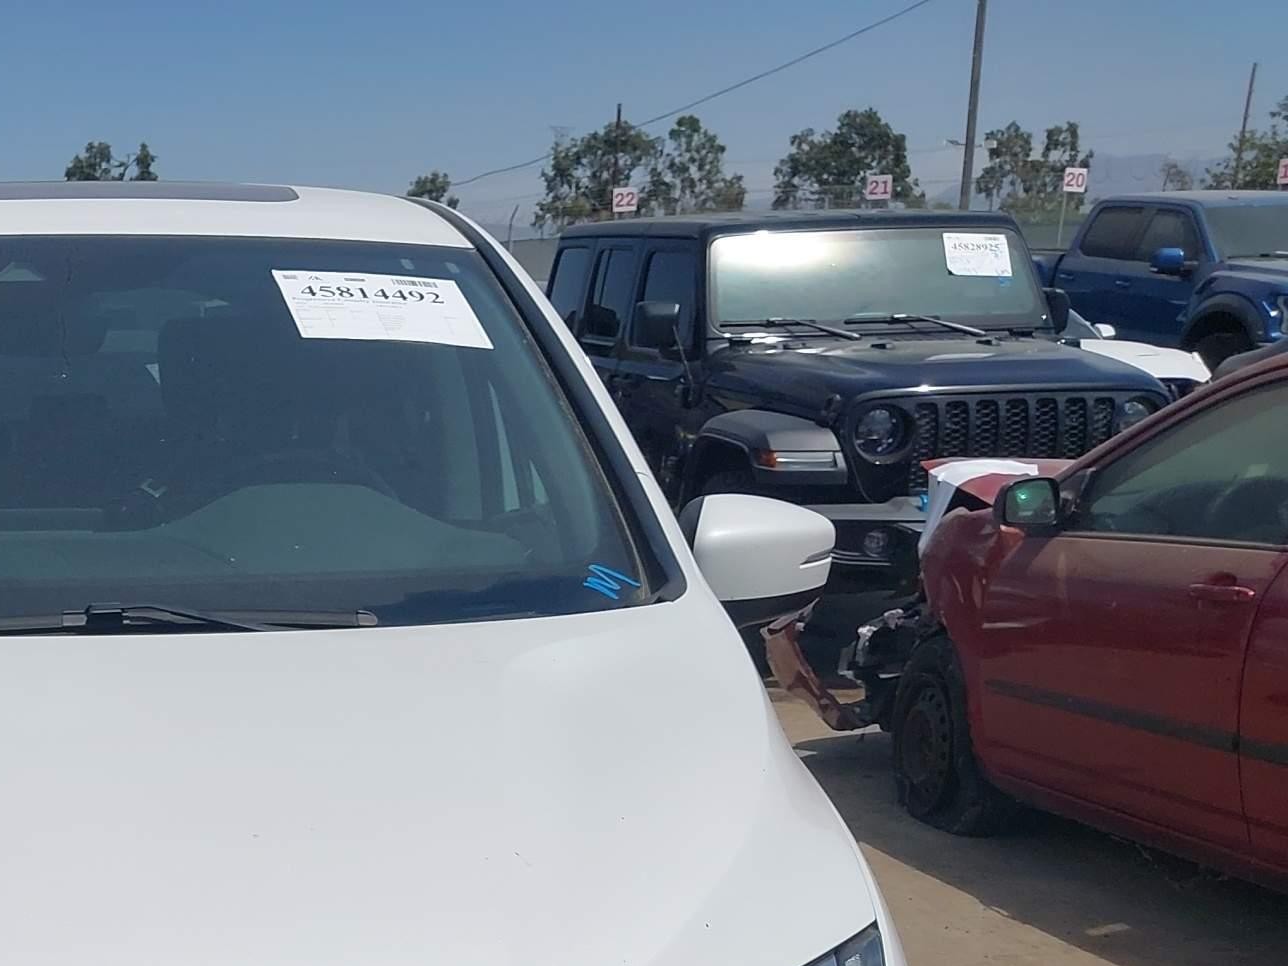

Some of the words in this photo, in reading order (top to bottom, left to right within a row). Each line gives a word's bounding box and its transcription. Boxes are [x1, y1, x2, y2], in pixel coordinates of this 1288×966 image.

[1065, 172, 1085, 187] 20
[869, 180, 888, 195] 21
[615, 192, 635, 207] 22
[300, 285, 445, 305] 45814492
